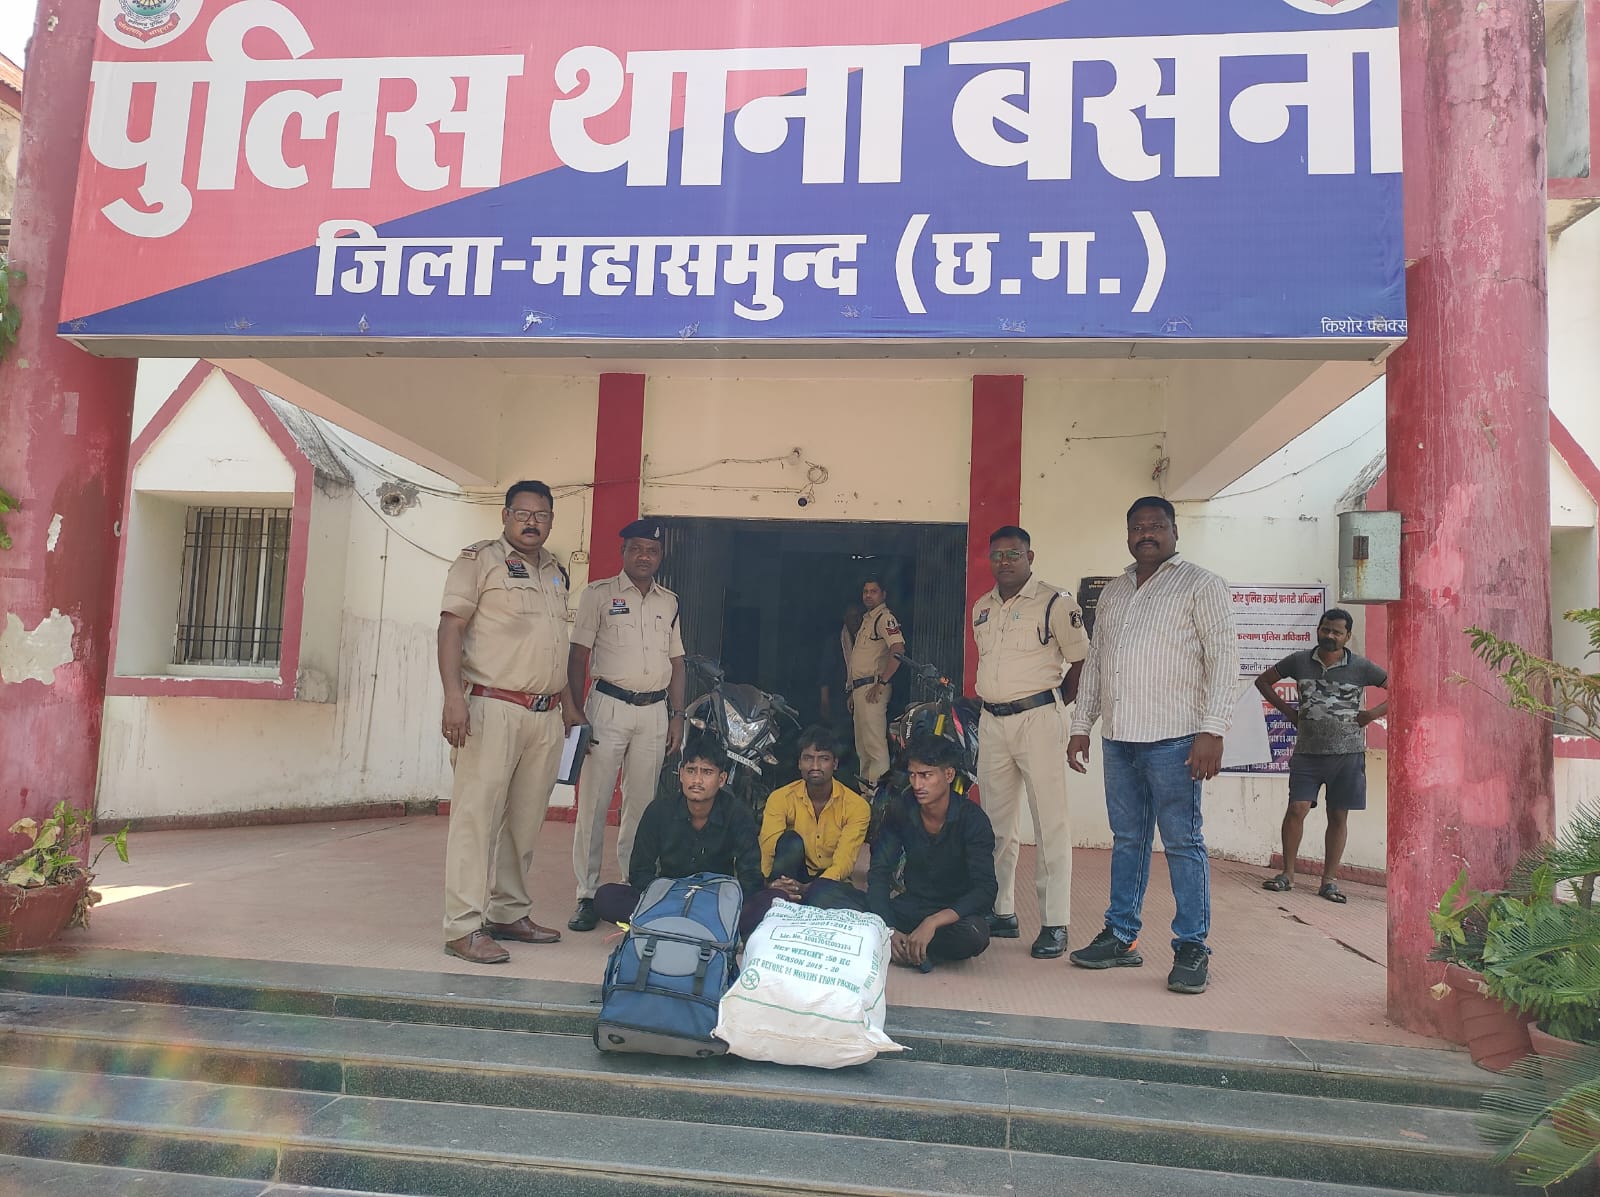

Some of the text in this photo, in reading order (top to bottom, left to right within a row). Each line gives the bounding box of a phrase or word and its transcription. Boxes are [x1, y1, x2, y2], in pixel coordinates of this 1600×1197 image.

[87, 0, 1404, 239] पुलिस थाना बसना
[315, 219, 867, 321] जिला-महासमुन्द
[1321, 316, 1363, 333] किशोर
[1245, 592, 1262, 606] पुलिस
[1261, 631, 1281, 642] पुलिस
[1282, 631, 1311, 641] अधिकारी
[1240, 662, 1261, 670] कालीन
[776, 953, 805, 966] SEASON
[791, 947, 823, 959] WEIGHT
[761, 959, 784, 974] BEFORE
[793, 968, 818, 982] MONTHS
[818, 974, 837, 986] FROM
